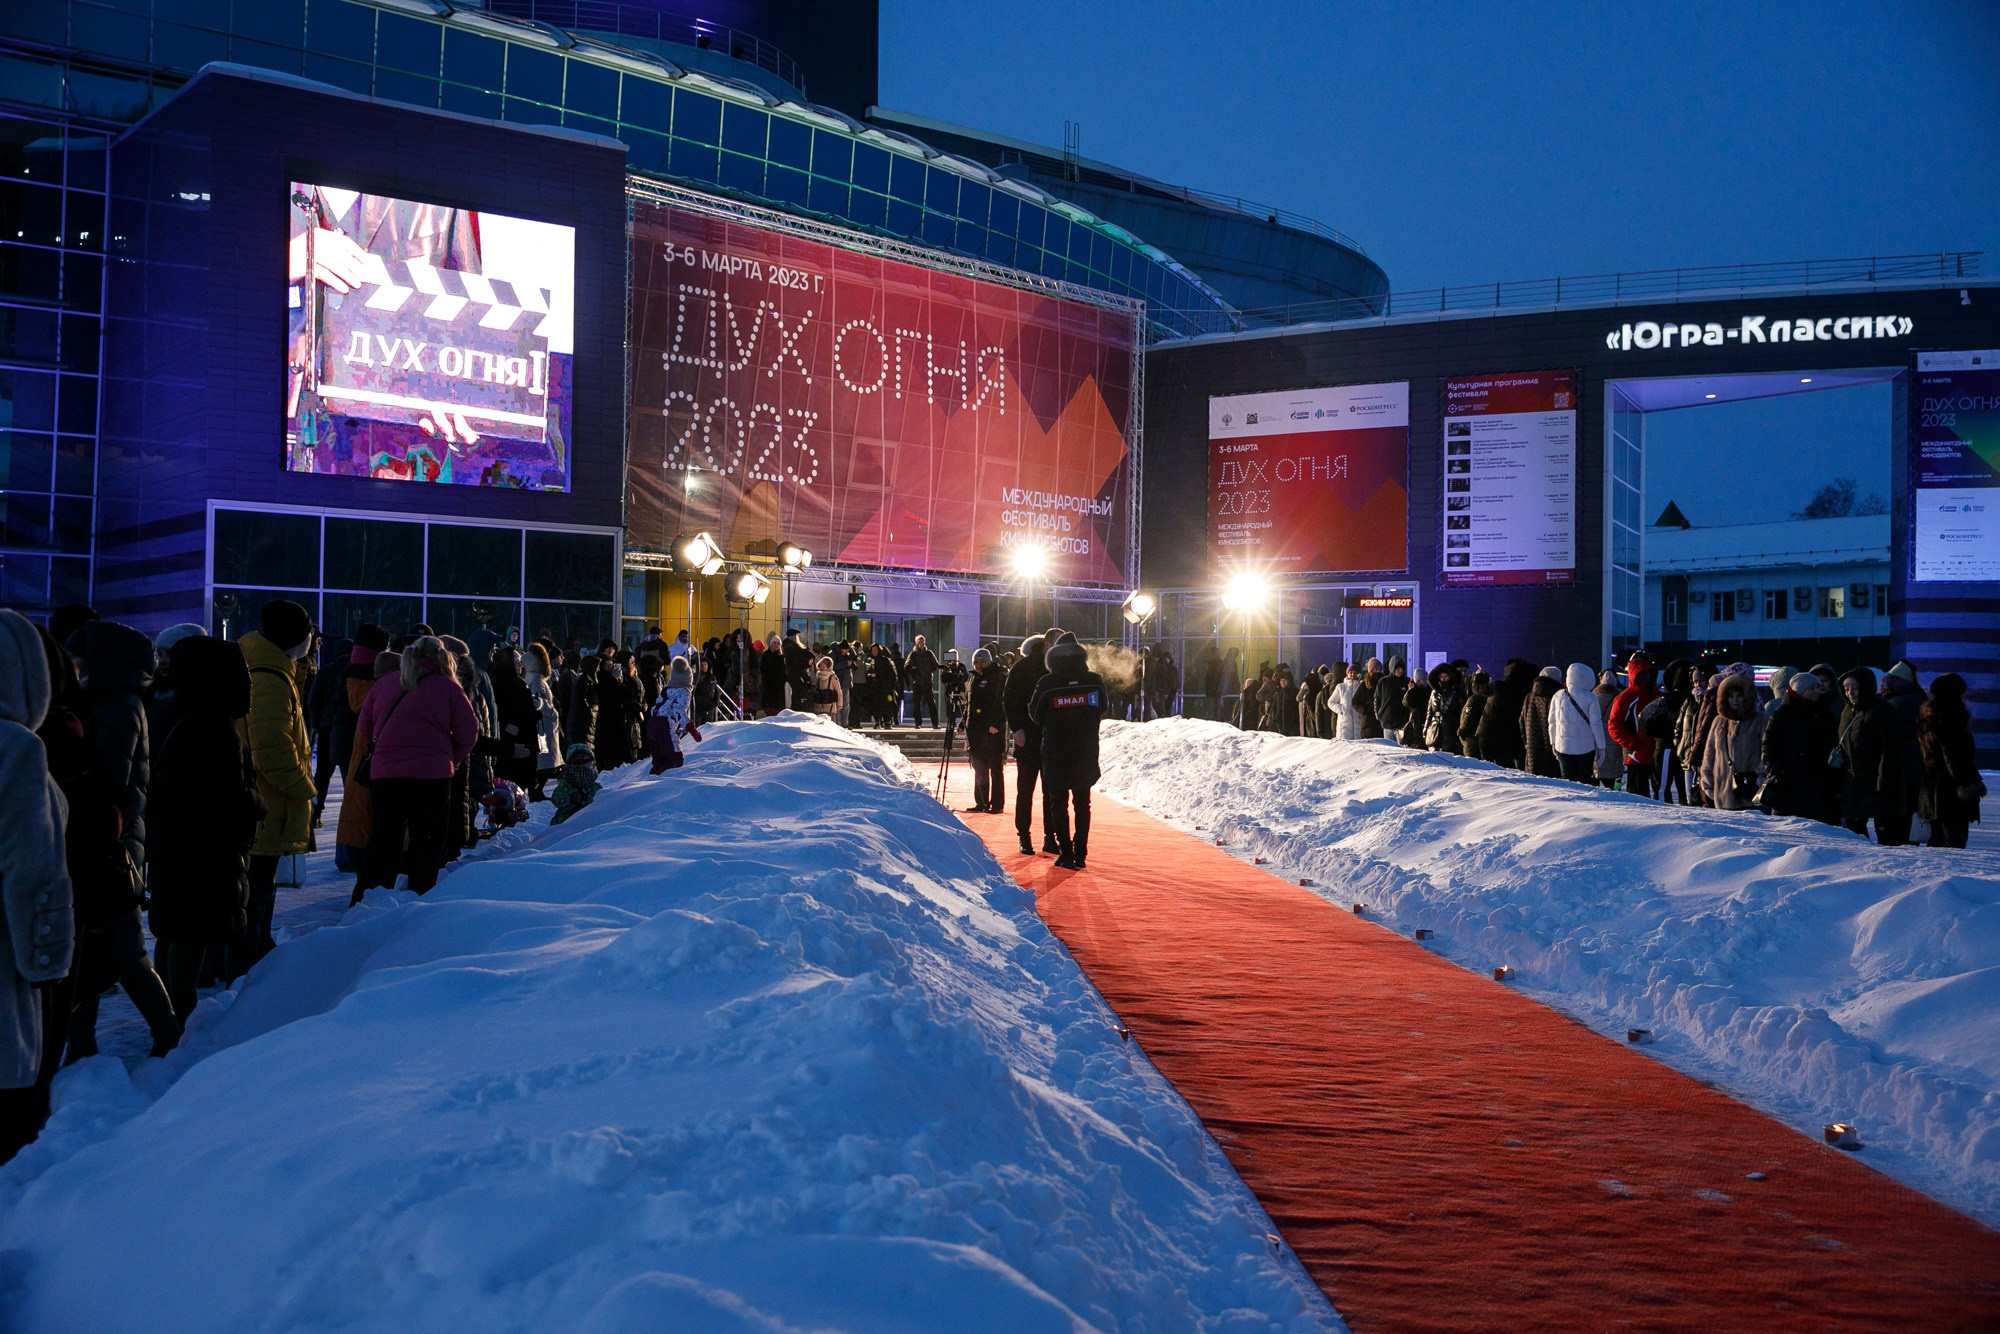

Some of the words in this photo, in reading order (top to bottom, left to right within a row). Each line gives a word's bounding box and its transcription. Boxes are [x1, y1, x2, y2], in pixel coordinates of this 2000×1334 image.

[664, 242, 696, 267] 3-6
[702, 250, 763, 282] МАРТА
[769, 265, 809, 291] 2023
[814, 275, 825, 295] Г.
[1606, 315, 1914, 351] «Югра-Классик»
[343, 330, 428, 373] ДУХ
[662, 283, 813, 385] ДУХ
[833, 319, 1006, 416] ОГНЯ
[1447, 381, 1493, 391] Культурная
[1494, 378, 1539, 387] программа
[1447, 390, 1489, 399] фестиваля
[1356, 403, 1398, 412] РОСКОНГРЕСС
[1921, 398, 1955, 412] ДУХ
[1921, 413, 1956, 428] 2023
[662, 390, 819, 486] 2023
[1219, 445, 1232, 454] 3-6
[1233, 443, 1259, 453] МАРТА
[1217, 459, 1269, 488] ДУХ
[1275, 454, 1348, 482] ОГНЯ
[1002, 486, 1113, 517] МЕЖДУНАРОДНЫЙ
[1217, 489, 1271, 515] 2023
[1001, 508, 1072, 533] ФЕСТИВАЛЬ
[1218, 520, 1272, 530] МЕЖДУНАРОДНЫЙ
[1360, 599, 1386, 607] РЕЖИМ
[1386, 598, 1412, 607] РАБОТ
[1057, 696, 1085, 706] ЯМАЛ
[1091, 694, 1096, 704] 1
